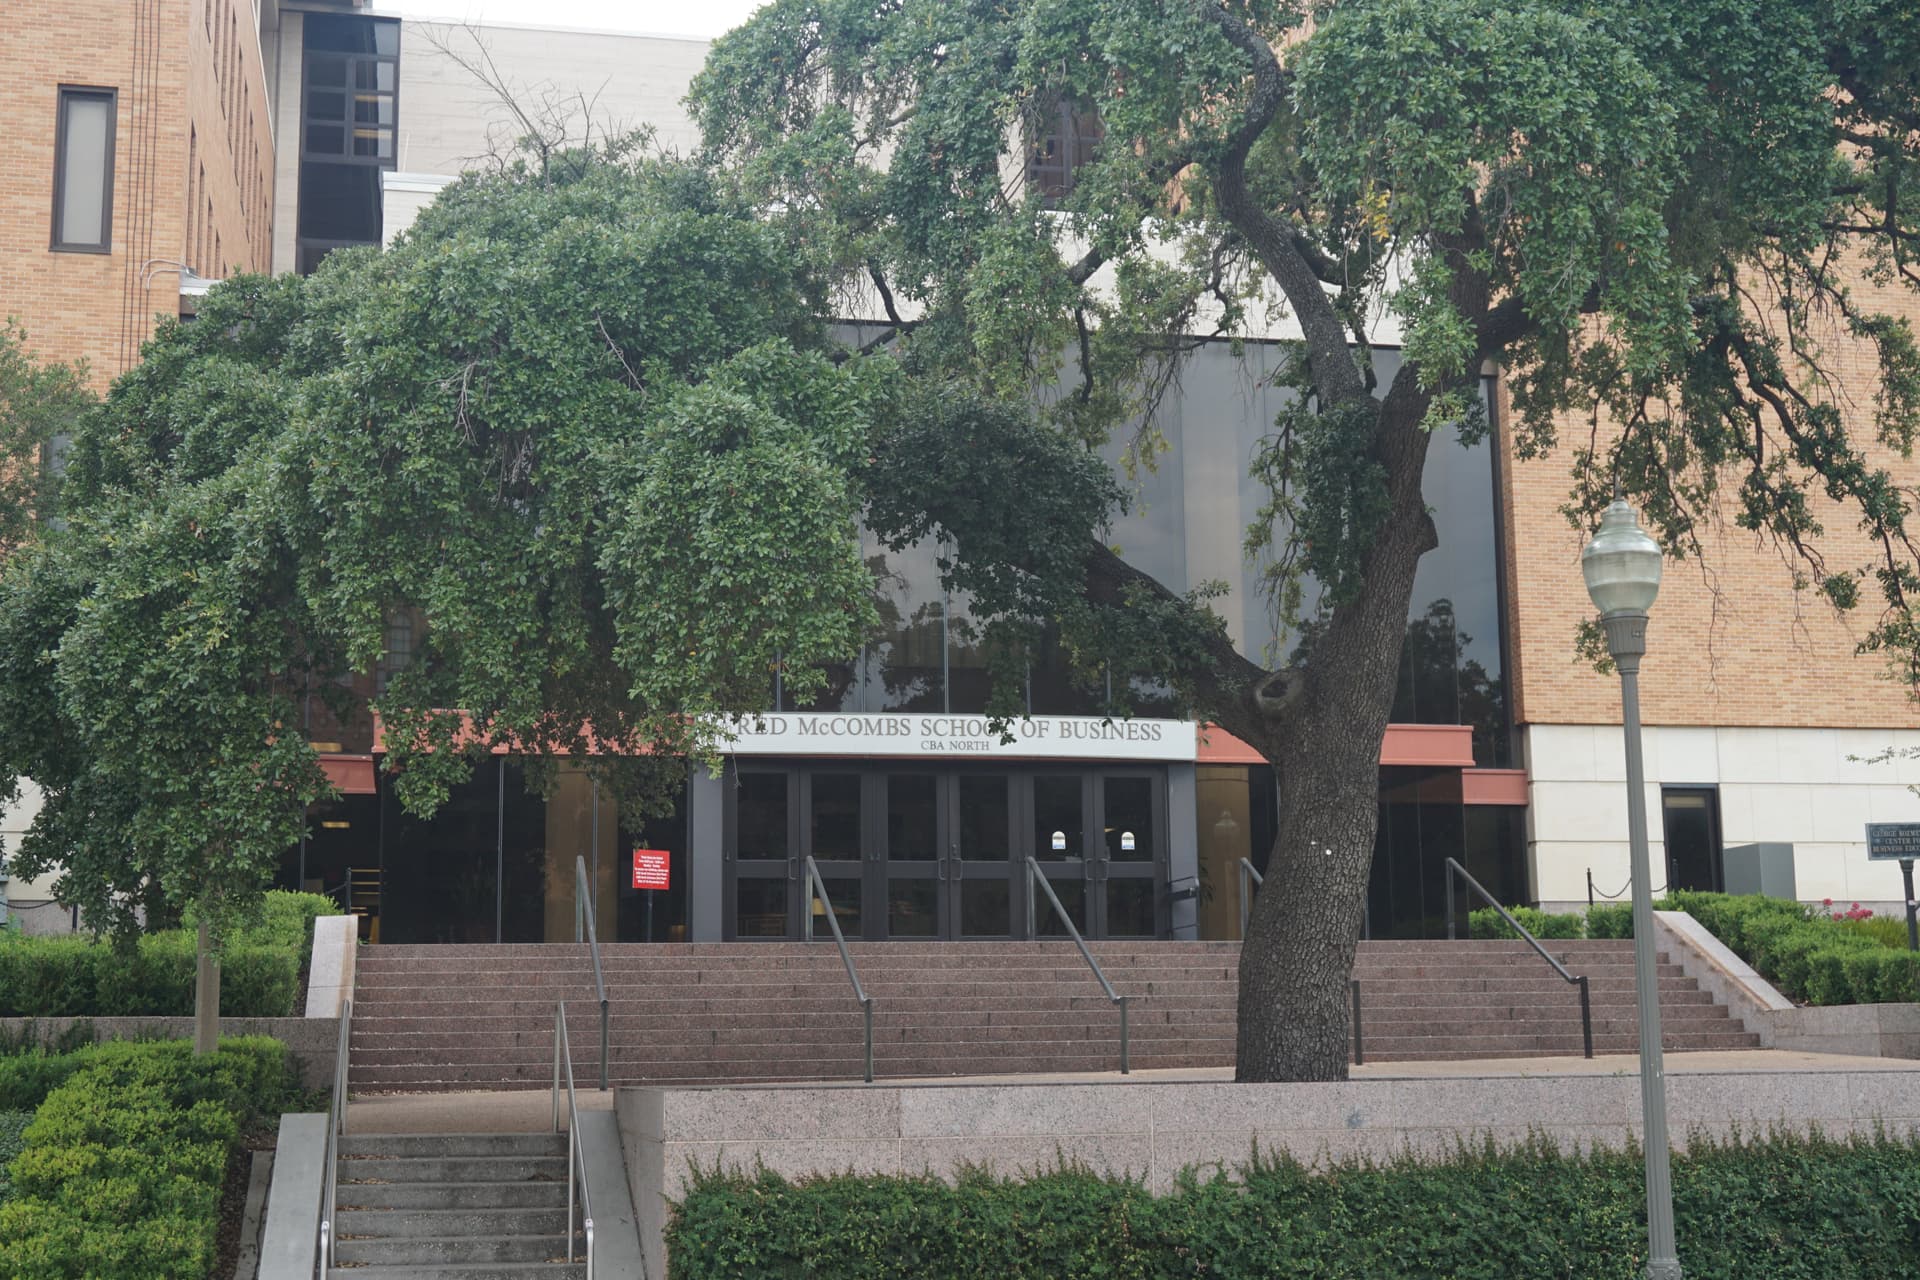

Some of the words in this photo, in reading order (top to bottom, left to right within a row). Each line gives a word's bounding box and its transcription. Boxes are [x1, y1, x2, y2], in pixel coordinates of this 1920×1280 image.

[737, 717, 788, 736] RED
[798, 717, 911, 737] McCOMBS
[1021, 720, 1050, 739] OF
[1059, 720, 1162, 742] BUSINESS
[920, 740, 945, 751] CBA
[949, 740, 990, 751] NORTH
